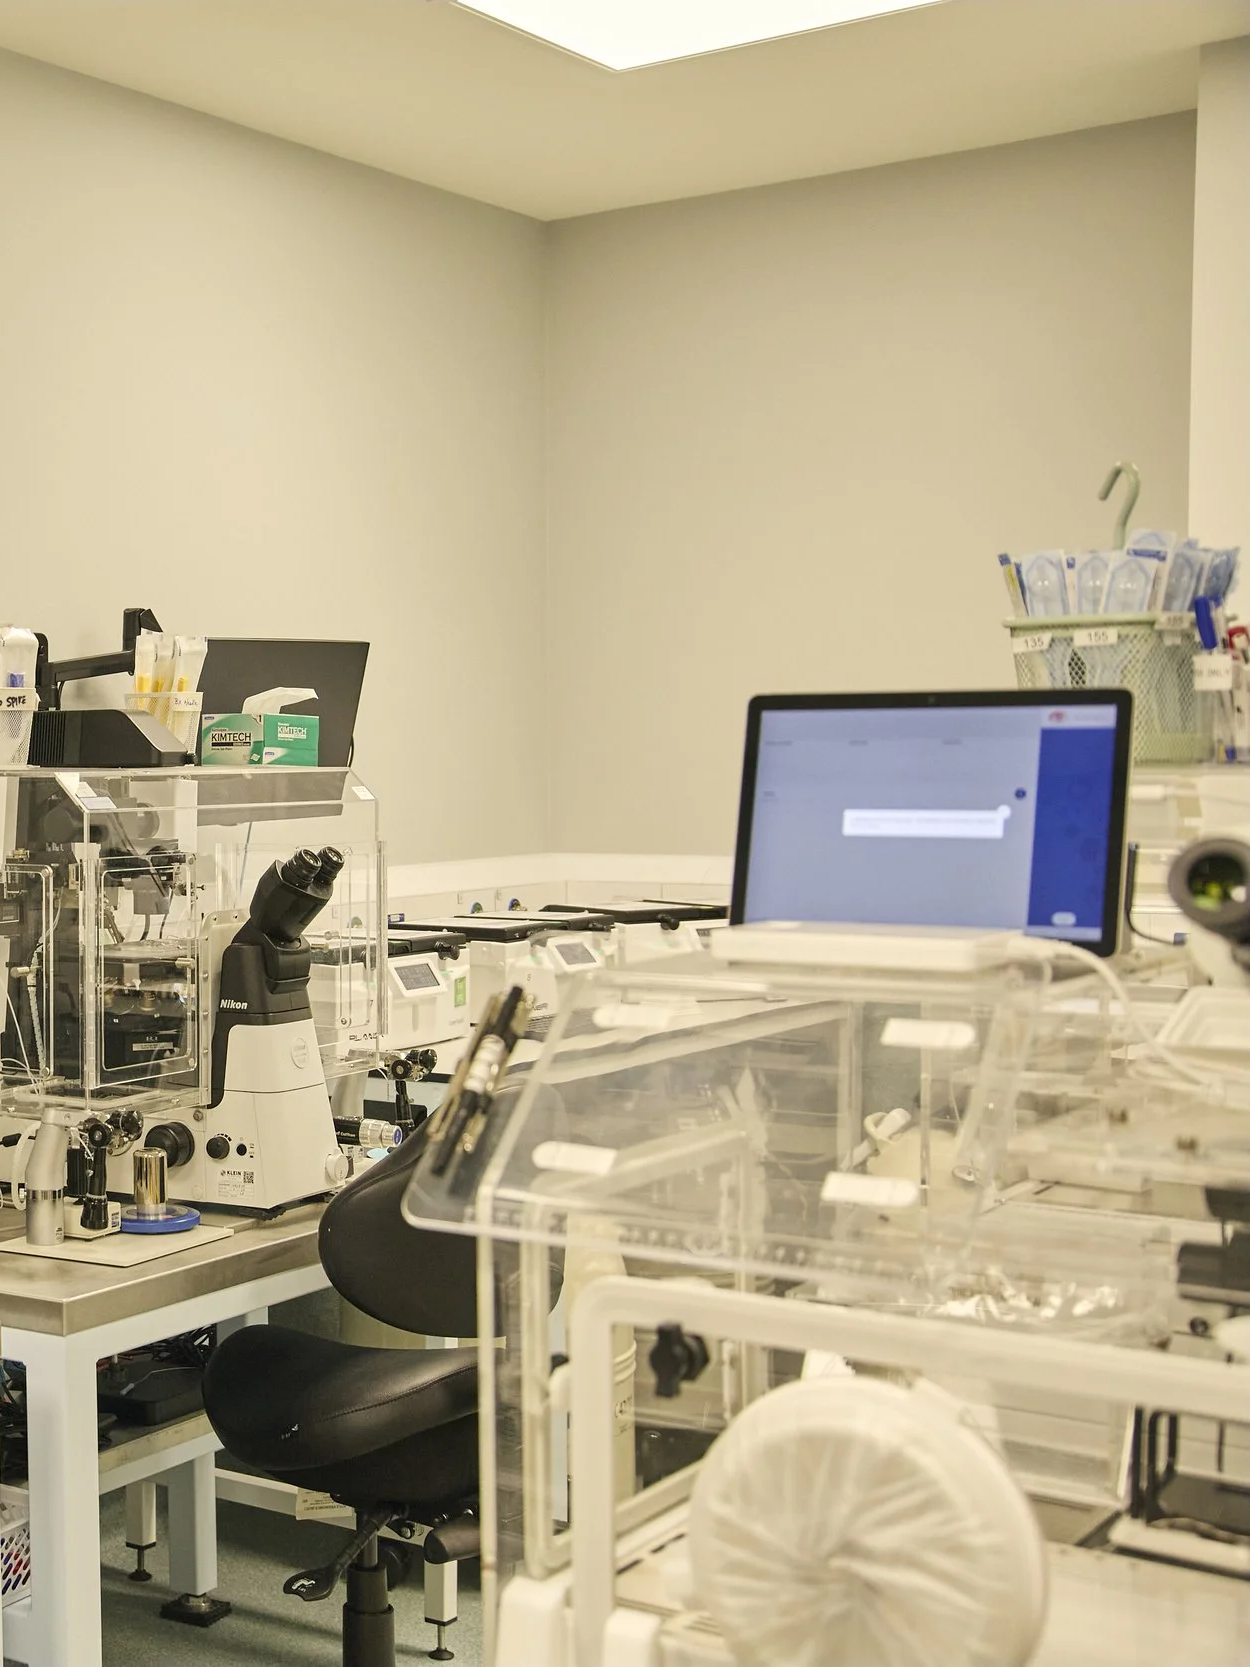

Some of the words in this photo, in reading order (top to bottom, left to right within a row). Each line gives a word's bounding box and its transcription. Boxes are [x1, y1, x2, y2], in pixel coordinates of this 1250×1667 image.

[1087, 632, 1109, 642] 155
[1023, 638, 1044, 649] 135
[278, 726, 307, 735] KIMTECH
[211, 732, 251, 742] KIMTECH
[220, 999, 248, 1010] Nikon
